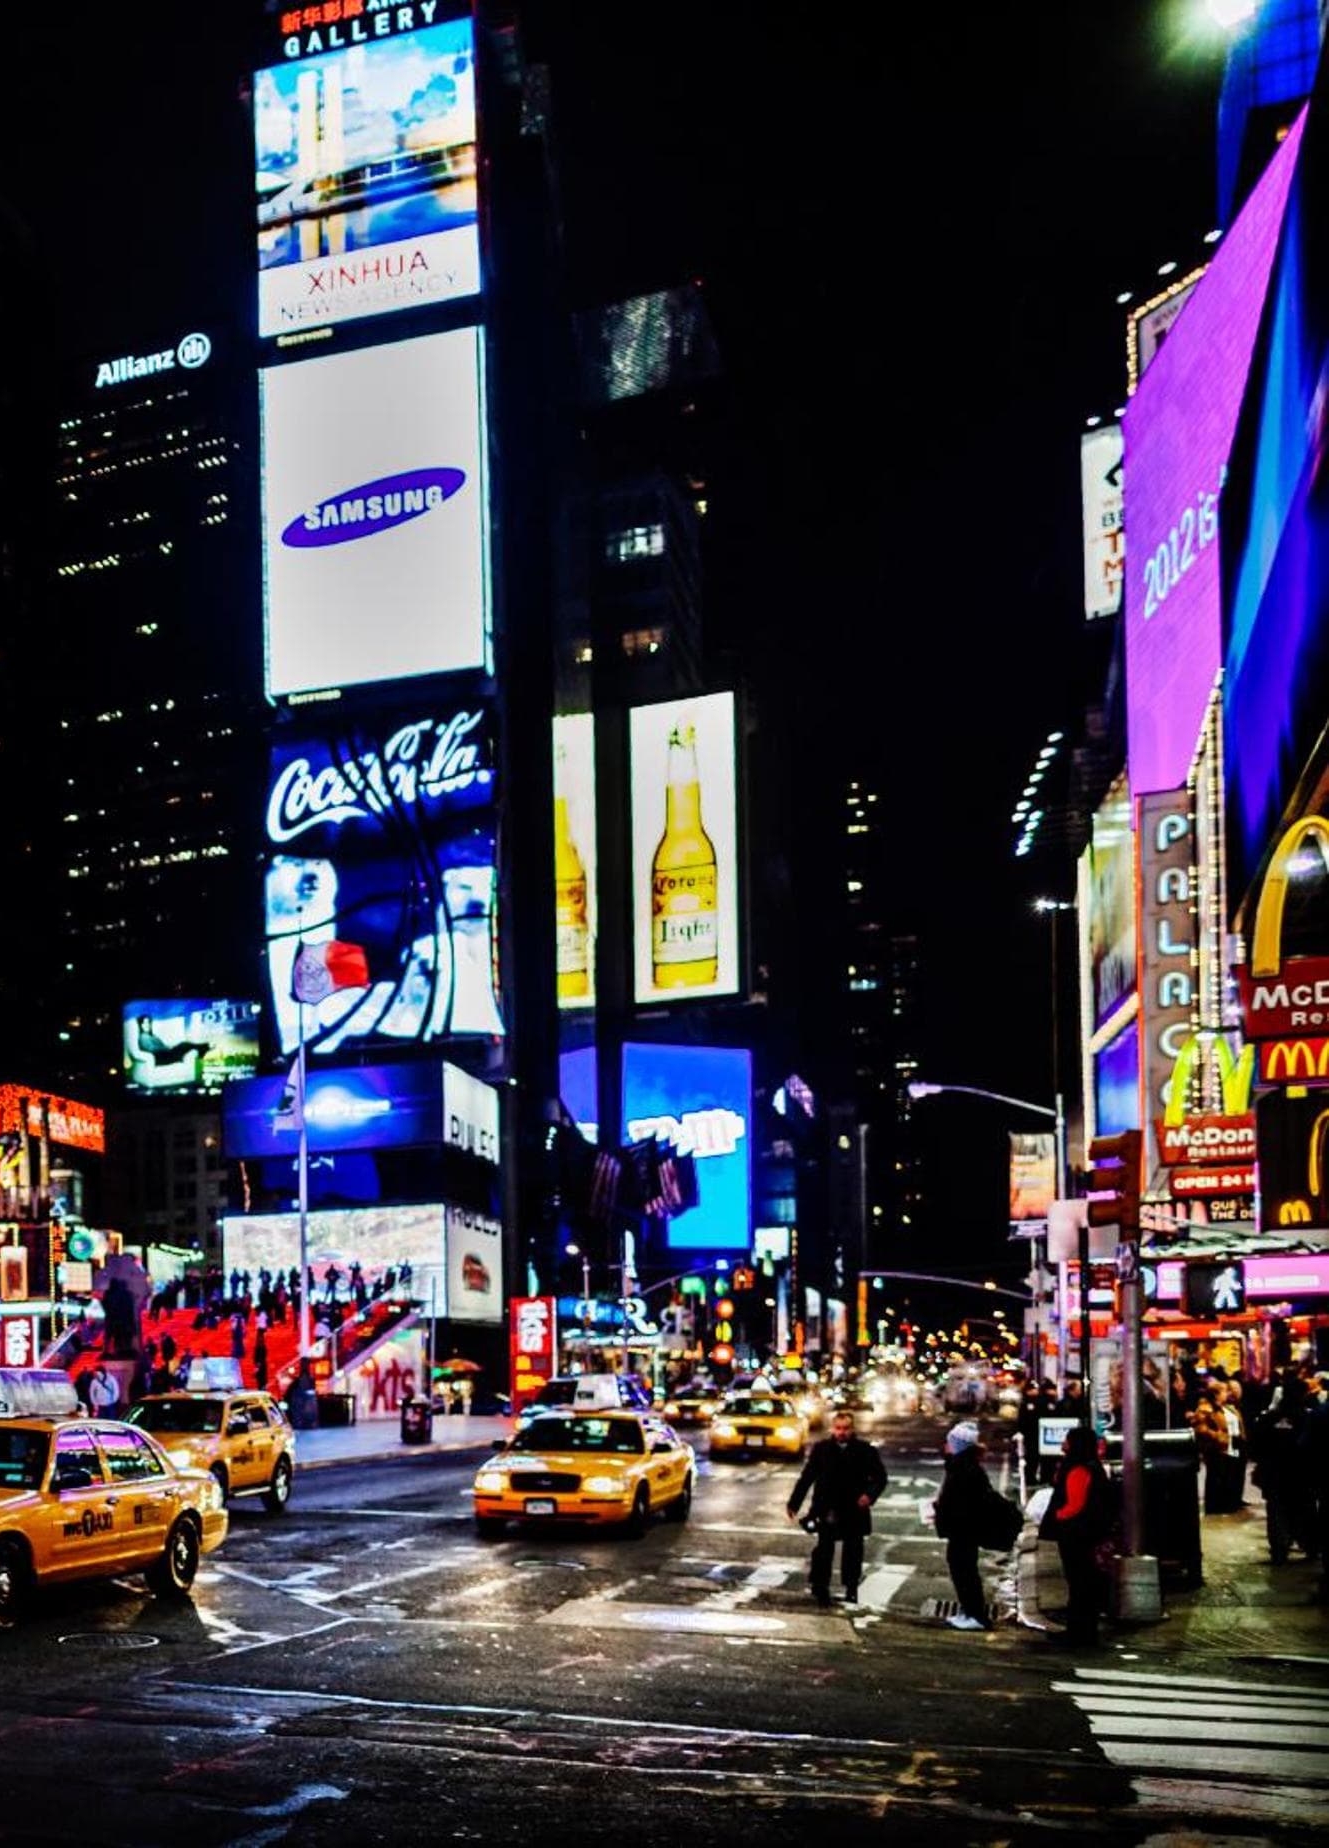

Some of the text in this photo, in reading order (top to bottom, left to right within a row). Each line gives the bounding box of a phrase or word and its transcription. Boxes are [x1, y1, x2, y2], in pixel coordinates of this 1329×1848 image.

[284, 1, 437, 58] GALLERY
[307, 251, 429, 295] XINHUA
[95, 348, 176, 388] Allianz
[304, 485, 443, 531] SAMSUNG
[1143, 508, 1197, 621] 2012
[1291, 1011, 1329, 1026] Re
[1174, 1176, 1219, 1189] OPEN
